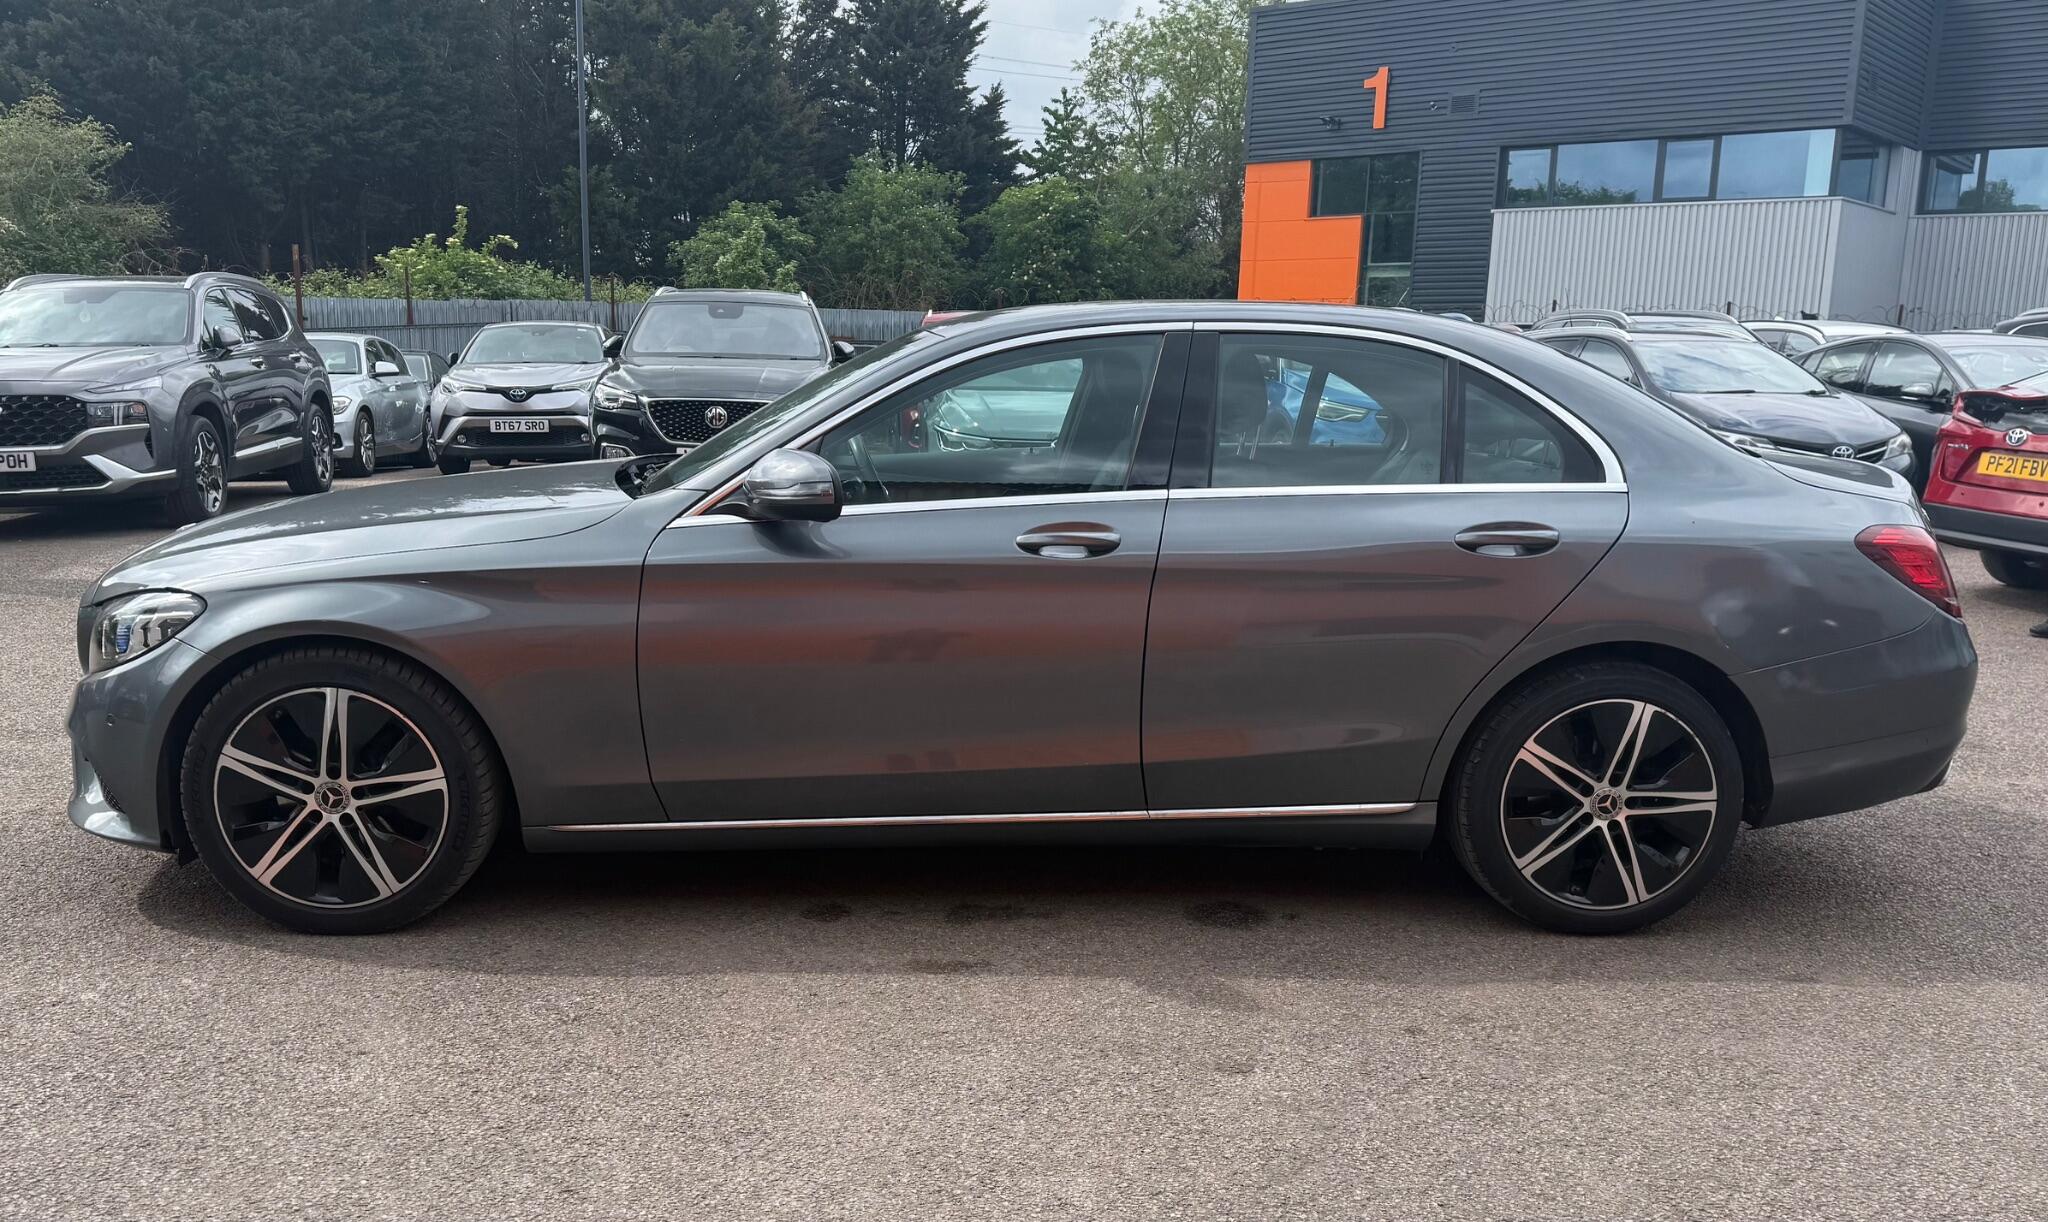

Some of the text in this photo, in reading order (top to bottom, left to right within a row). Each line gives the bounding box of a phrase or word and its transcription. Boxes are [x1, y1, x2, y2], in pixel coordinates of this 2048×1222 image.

[1364, 67, 1388, 128] 1
[495, 421, 521, 430] BT67
[706, 407, 726, 427] MG
[1986, 455, 2018, 474] PF21
